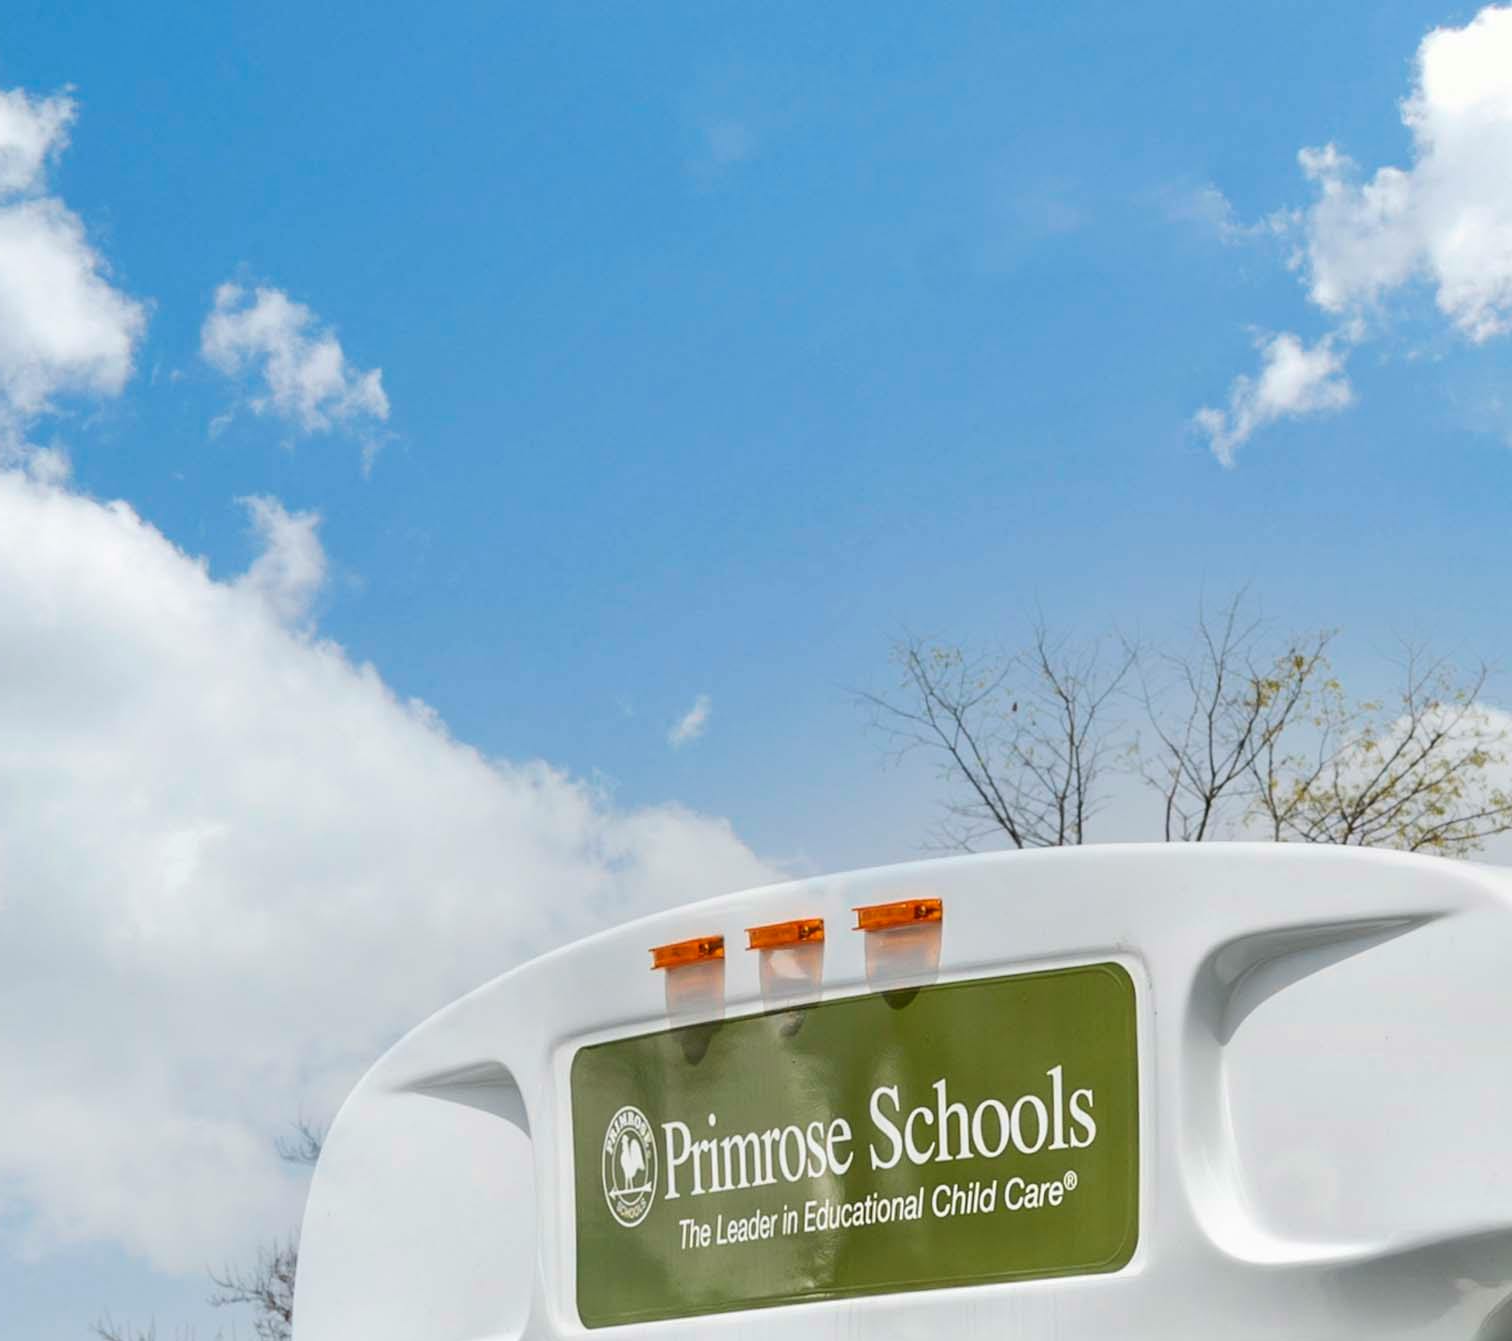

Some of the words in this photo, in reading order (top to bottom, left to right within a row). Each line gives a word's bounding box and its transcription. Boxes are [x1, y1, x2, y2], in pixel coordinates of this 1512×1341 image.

[661, 1113, 854, 1200] Primrose
[869, 1064, 1097, 1171] Schools
[679, 1218, 712, 1250] The
[716, 1209, 779, 1244] Leader
[782, 1205, 799, 1235] in
[803, 1187, 925, 1233] Educational
[932, 1179, 997, 1217] Child
